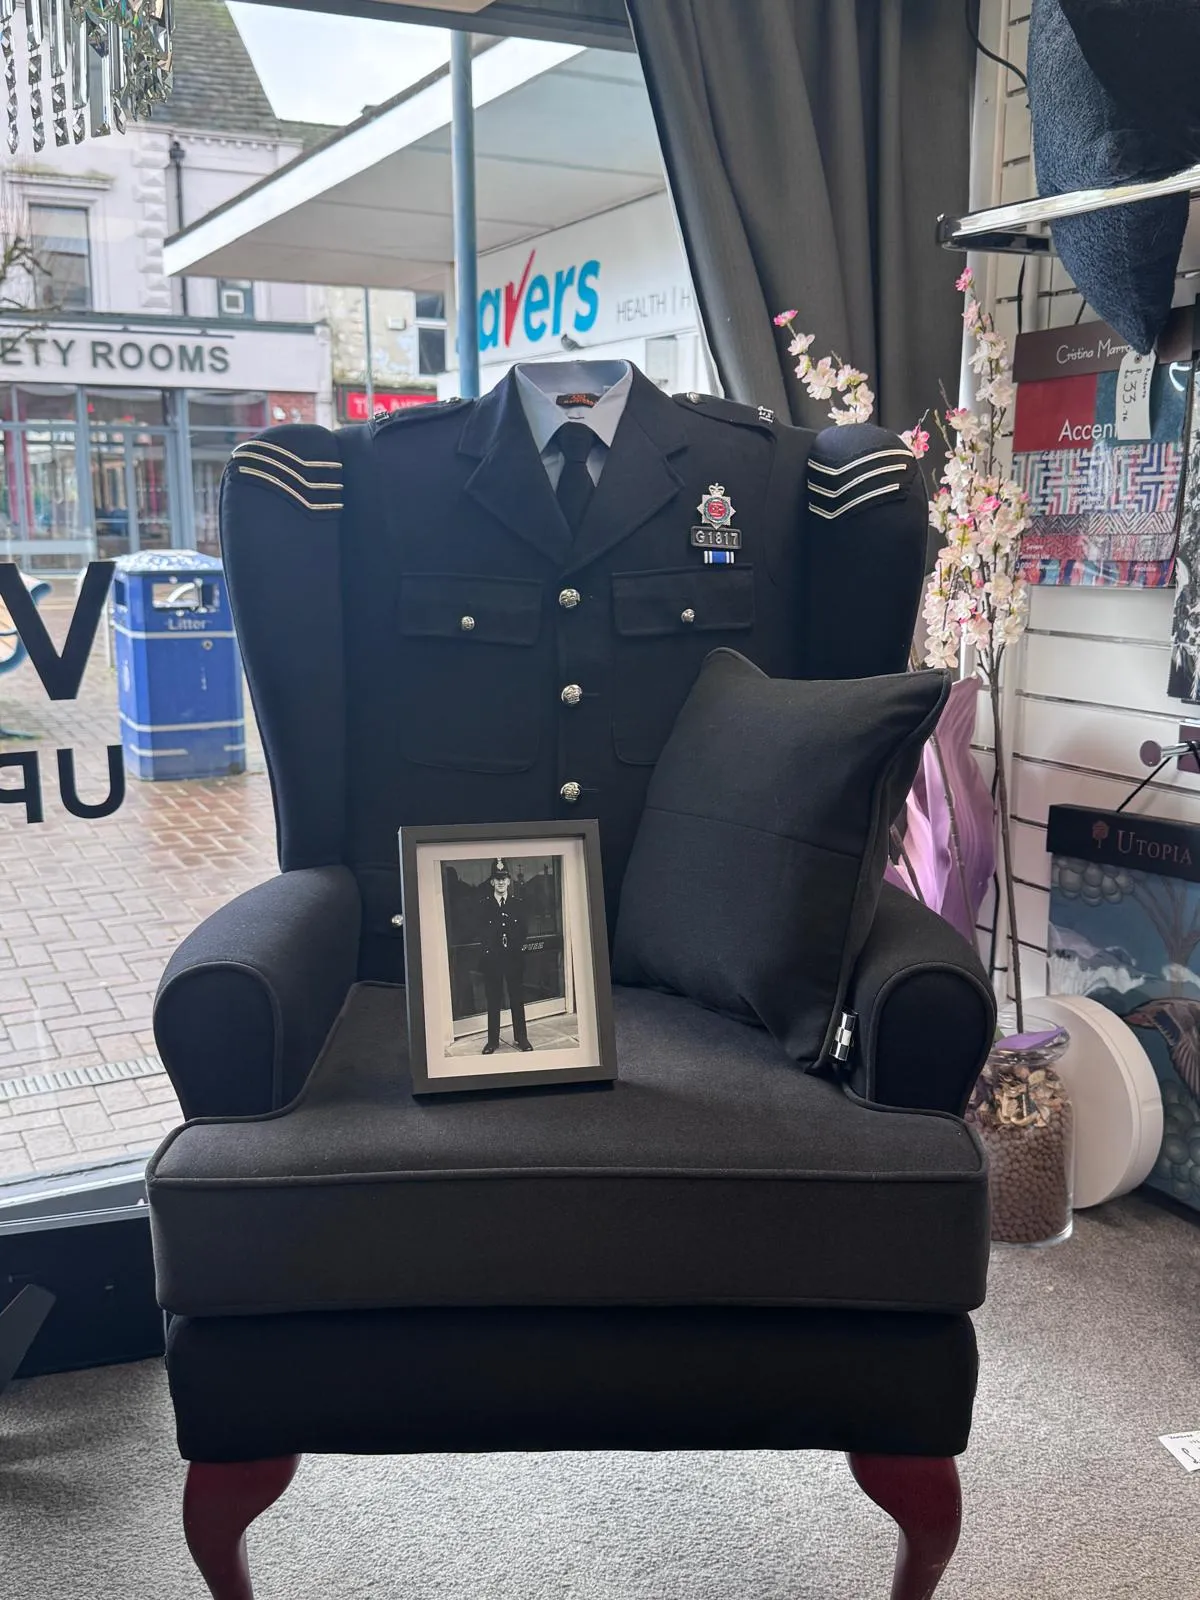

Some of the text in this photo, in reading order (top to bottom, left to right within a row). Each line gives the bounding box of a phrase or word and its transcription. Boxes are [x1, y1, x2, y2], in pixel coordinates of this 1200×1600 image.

[477, 249, 601, 352] avers
[616, 291, 667, 324] HEALTH
[91, 340, 230, 374] ROOMS
[1056, 344, 1094, 364] Cristina
[695, 530, 738, 546] G1817
[167, 618, 206, 631] Litter
